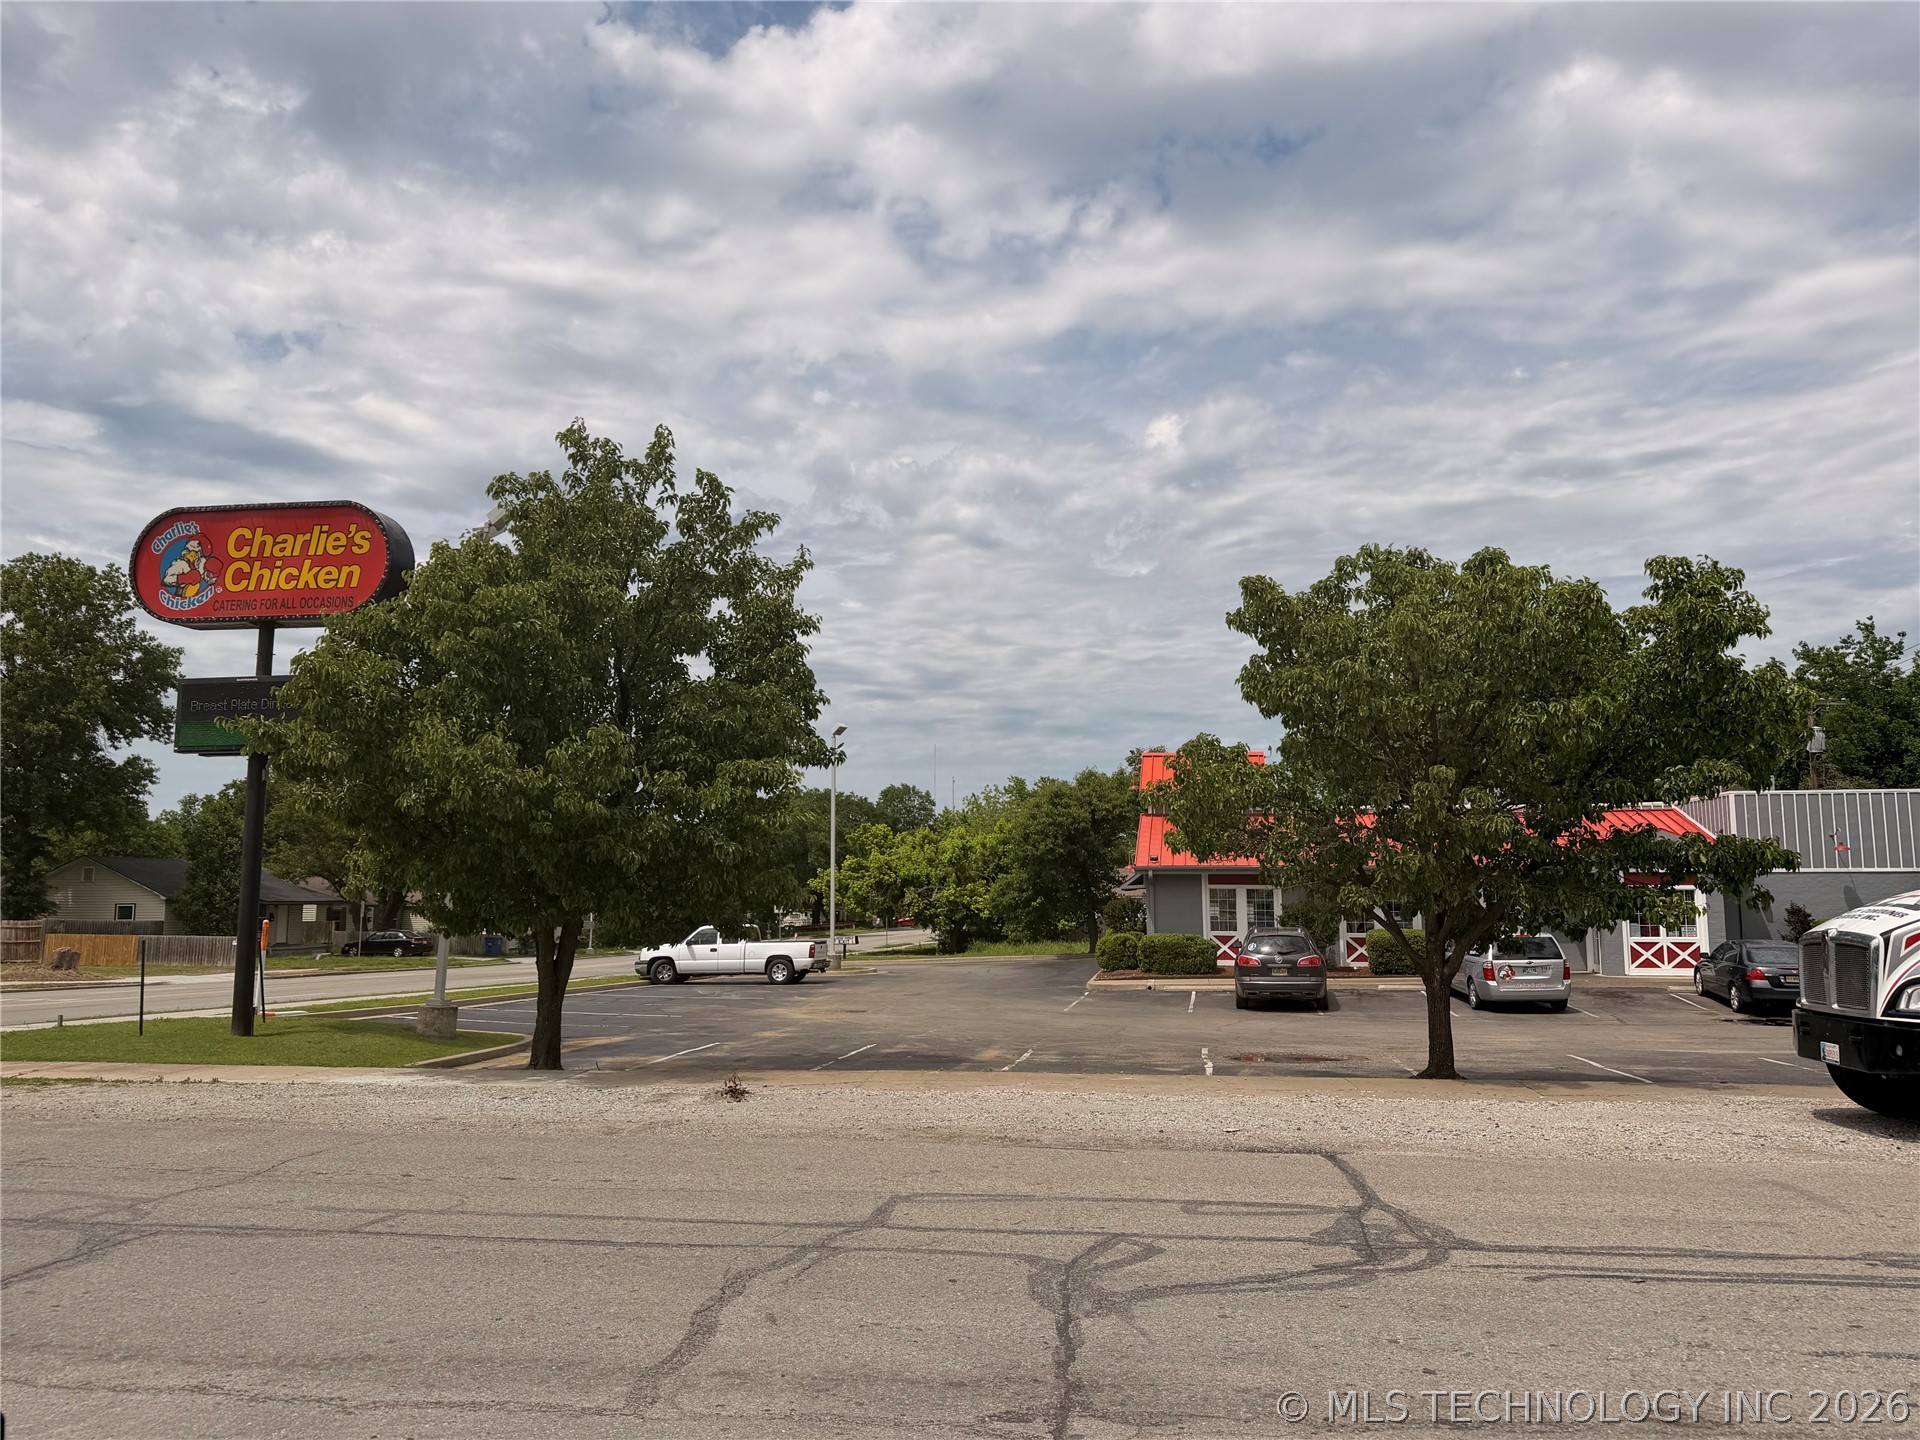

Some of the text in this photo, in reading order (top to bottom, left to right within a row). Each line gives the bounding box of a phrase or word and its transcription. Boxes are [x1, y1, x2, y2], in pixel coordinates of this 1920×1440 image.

[152, 521, 200, 554] Charlie's
[227, 524, 372, 558] Charlie's
[224, 559, 361, 592] Chicken
[159, 585, 214, 611] Chicken
[213, 596, 354, 612] CATERING FOR ALL OCCASIONS
[190, 699, 227, 712] Breast
[230, 698, 258, 711] Plate
